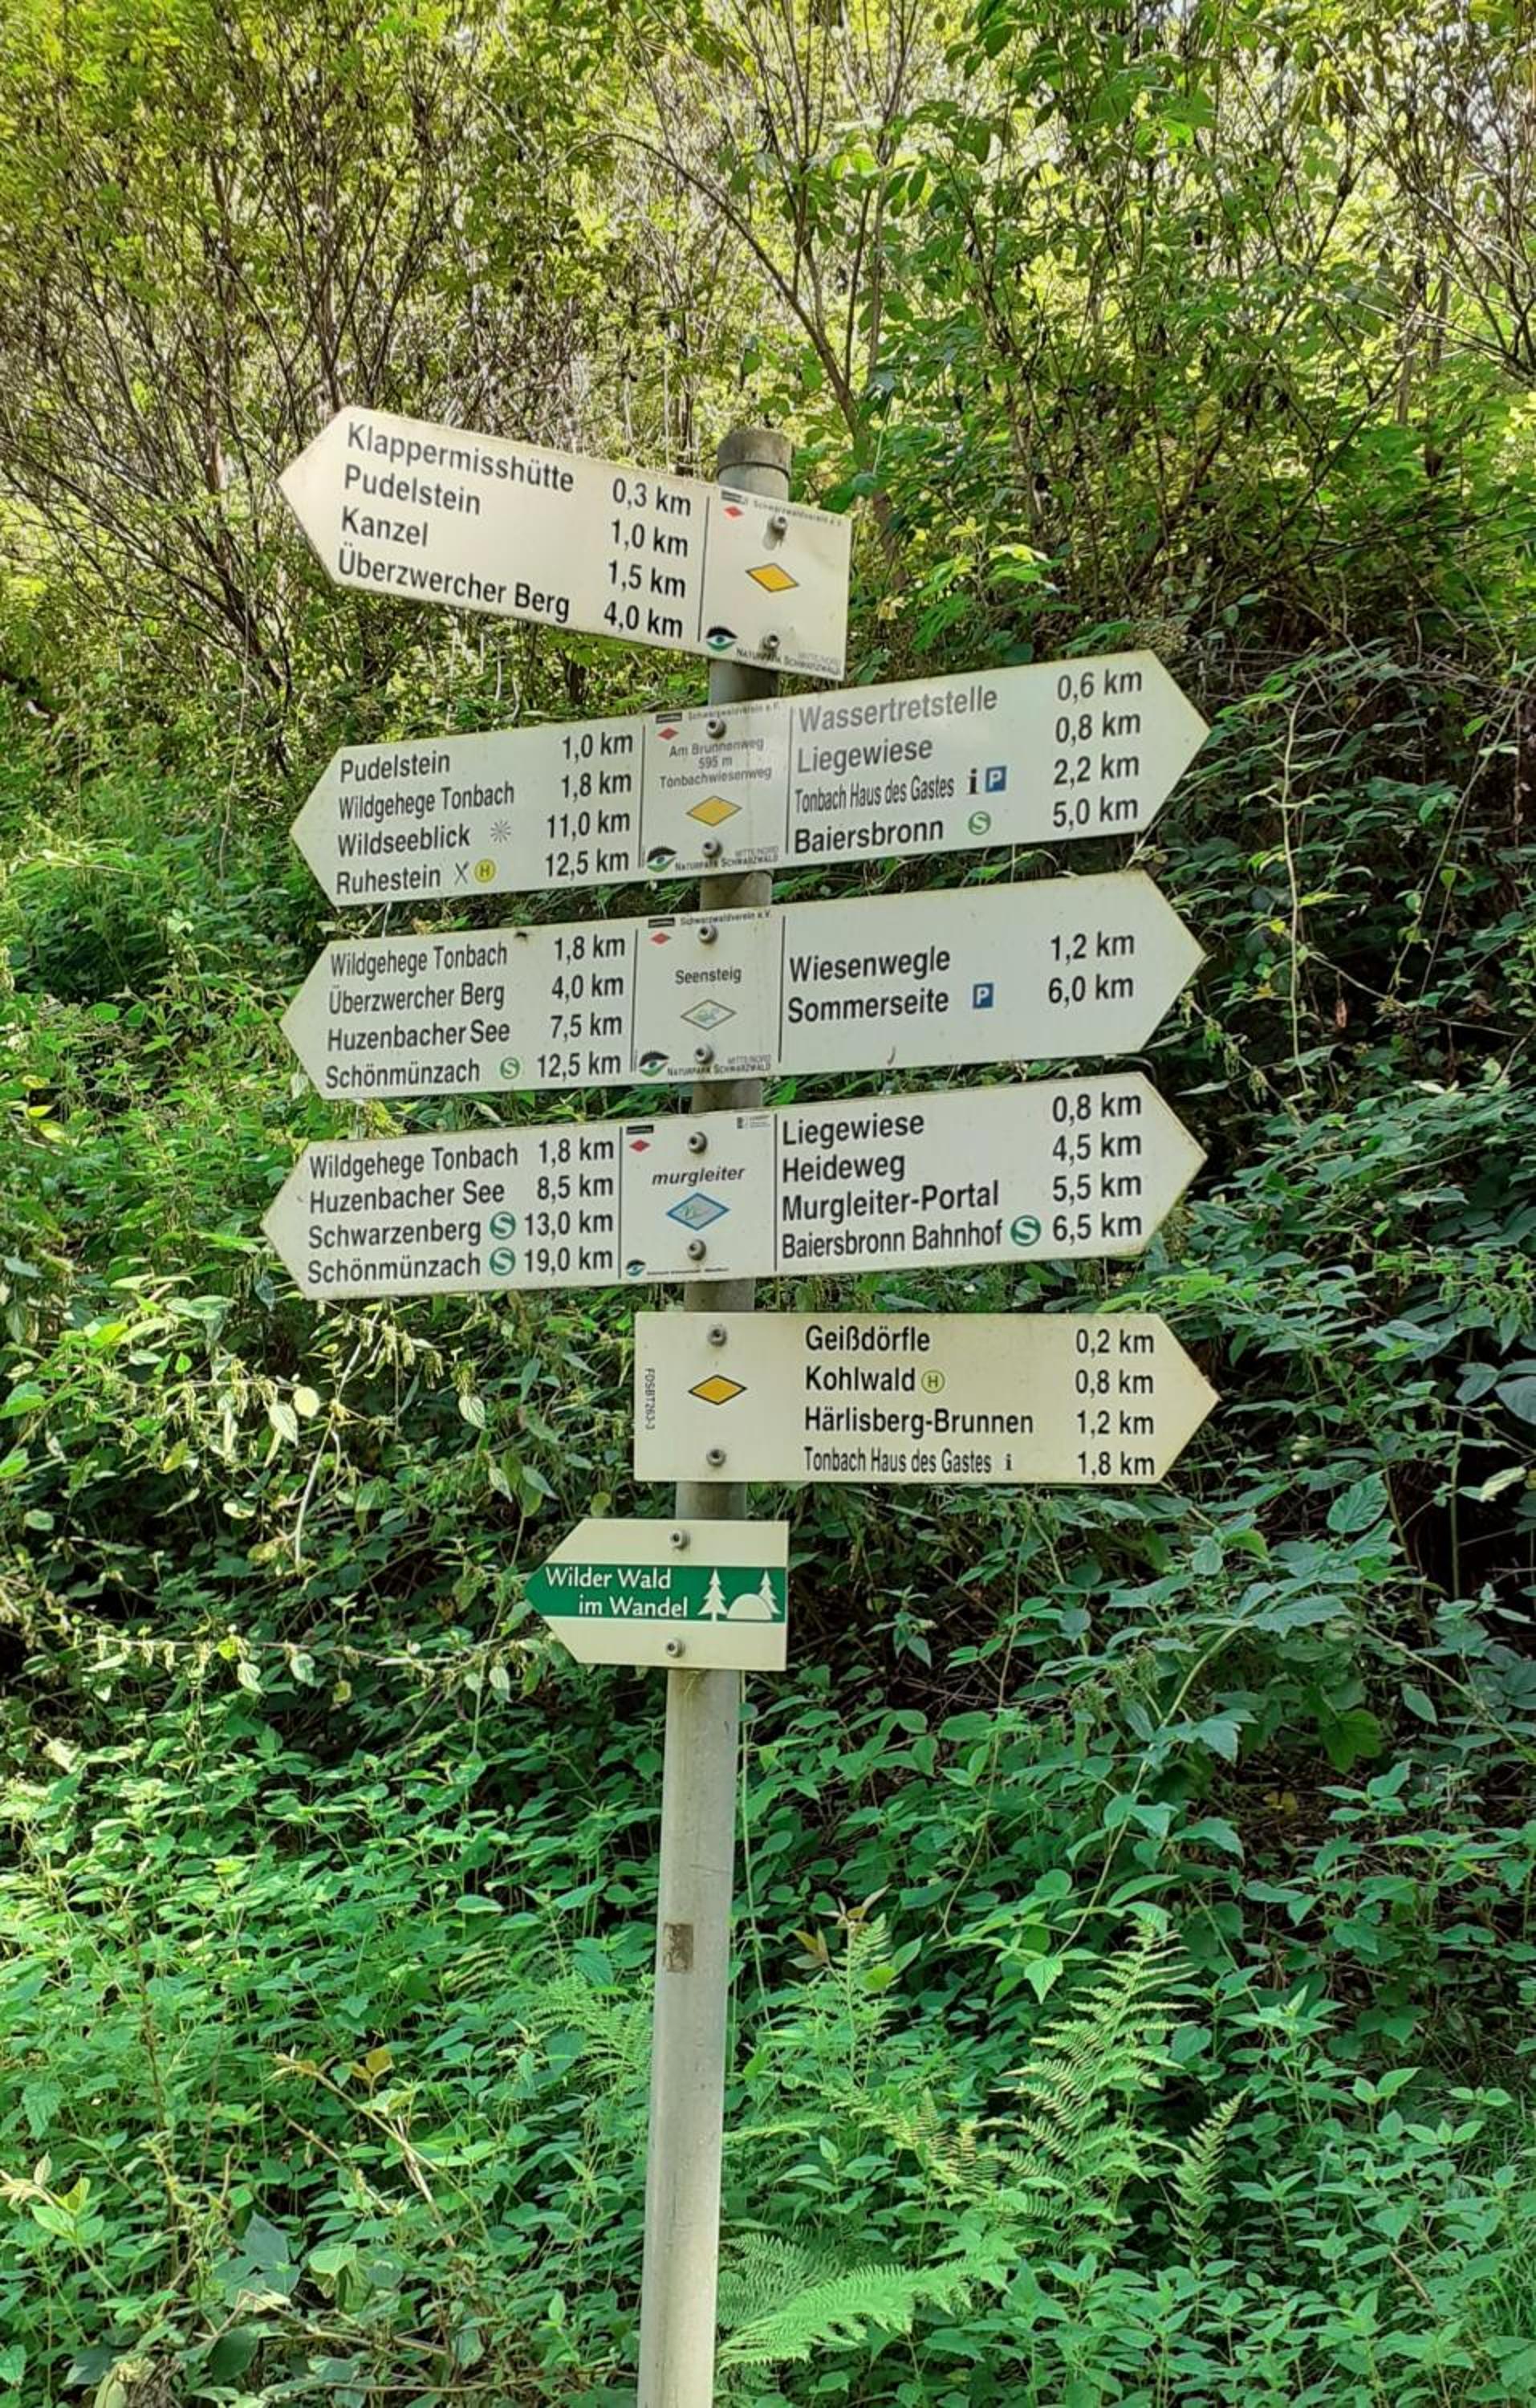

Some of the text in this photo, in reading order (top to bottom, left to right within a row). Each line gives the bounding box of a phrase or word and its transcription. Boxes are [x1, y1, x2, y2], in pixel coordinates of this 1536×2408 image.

[349, 424, 573, 492] Klappermisshütte
[613, 478, 646, 509] 0,3
[656, 486, 690, 516] km
[345, 464, 687, 556] Pudelstein 1,0 km
[343, 506, 685, 597] Kanzel 1,5 km
[339, 543, 682, 638] Überzwercher Berg 4,0 km
[800, 670, 1141, 732] Wassertretstelle 0,6 km
[341, 732, 632, 783] Pudelstein 1,0 km
[669, 738, 764, 757] Am Brunnenweg
[699, 757, 732, 769] 595 m
[798, 713, 1140, 775] Liegewiese 0,8 km
[339, 771, 631, 822] Wildgehege Tonbach 1,8 km
[660, 767, 771, 787] Tonbachwiesenweg
[795, 785, 846, 813] Tonbach
[851, 783, 881, 807] Haus
[885, 779, 906, 803] des
[912, 776, 953, 801] Gastes
[1054, 756, 1090, 787] 2,2
[1101, 756, 1139, 779] km
[339, 811, 629, 856] Wildseeblick 11,0 km
[795, 820, 943, 853] Baiersbronn
[1054, 799, 1090, 831] 5,0
[1100, 799, 1137, 822] km
[337, 868, 440, 894] Ruhestein
[547, 851, 587, 879] 12,5
[597, 849, 628, 872] km
[331, 935, 624, 980] Wildgehege Tonbach 1,8 km
[676, 967, 742, 984] Seensteig
[790, 932, 1134, 982] Wiesenwegle 1,2 km
[330, 974, 623, 1015] Überzwercher Berg 4,0 km
[789, 989, 949, 1023] Sommerseite
[1049, 976, 1085, 1007] 6,0
[1096, 975, 1133, 999] km
[328, 1013, 621, 1051] Huzenbacher See 7,5 km
[327, 1058, 479, 1088] Schönmünzach
[538, 1053, 579, 1080] 12,5
[589, 1051, 620, 1075] km
[783, 1115, 924, 1149] Liegewiese
[1053, 1094, 1091, 1125] 0,8
[1102, 1093, 1140, 1117] km
[310, 1138, 613, 1182] Wildgehege Tonbach 1,8 km
[652, 1168, 745, 1186] murgleiter
[783, 1133, 1140, 1182] Heideweg 4,5 km
[311, 1174, 612, 1214] Huzenbacher See 8,5 km
[783, 1173, 1141, 1224] Murgleiter-Portal 5,5 km
[310, 1220, 481, 1249] Schwarzenberg
[525, 1211, 570, 1239] 13,0
[579, 1210, 612, 1233] km
[783, 1230, 904, 1259] Baiersbronn
[913, 1219, 1002, 1250] Bahnhof
[1053, 1214, 1091, 1244] 6,5
[1102, 1214, 1141, 1237] km
[308, 1252, 480, 1283] Schönmünzach
[525, 1247, 570, 1275] 19,0
[579, 1247, 612, 1269] km
[806, 1325, 1153, 1357] Geißdörfle 0,2 km
[807, 1366, 915, 1391] Kohlwald
[1076, 1369, 1109, 1397] 0,8
[1119, 1369, 1152, 1393] km
[806, 1407, 1153, 1439] Härlisberg-Brunnen 1,2 km
[804, 1446, 865, 1471] Tonbach
[872, 1448, 906, 1472] Haus
[912, 1450, 936, 1473] des
[942, 1449, 991, 1473] Gastes
[1079, 1451, 1111, 1479] 1,8
[1121, 1451, 1154, 1475] km
[546, 1567, 671, 1589] Wilder Wald
[579, 1595, 688, 1617] im Wandel
